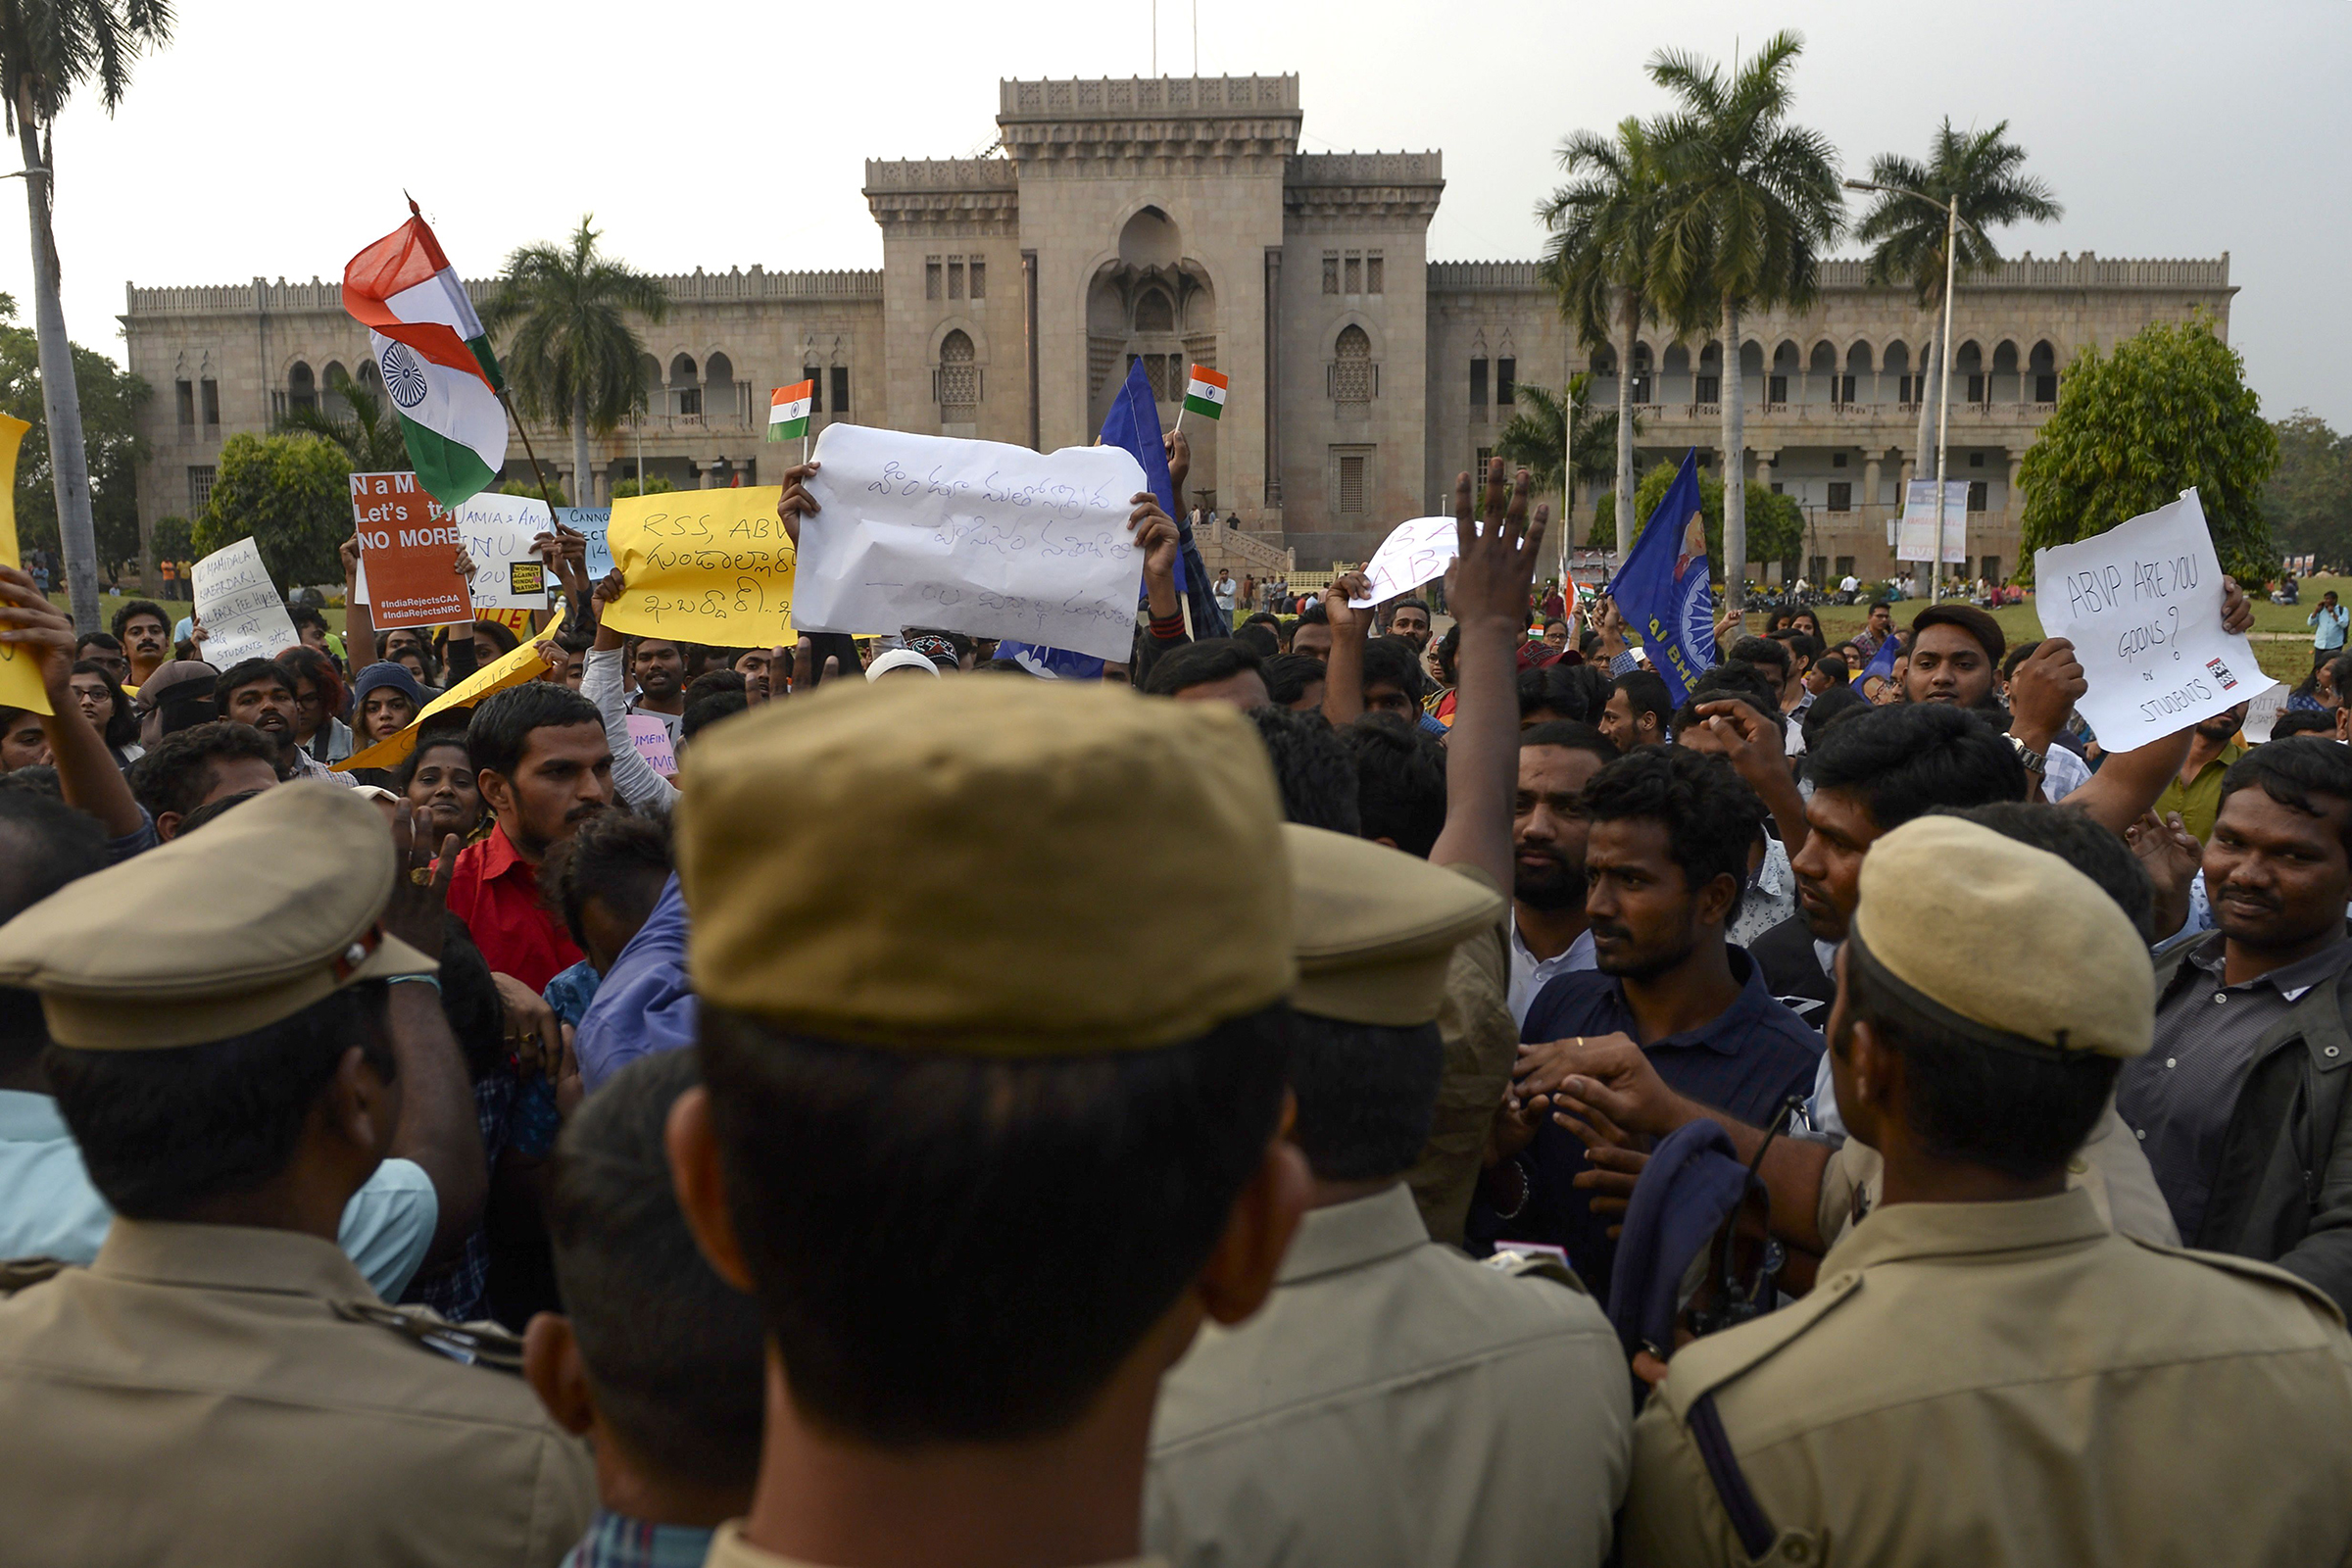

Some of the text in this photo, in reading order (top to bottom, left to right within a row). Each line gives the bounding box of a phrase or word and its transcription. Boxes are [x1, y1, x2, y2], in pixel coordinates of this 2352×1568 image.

[354, 502, 408, 523] Let's
[456, 502, 503, 524] JAMIA
[570, 510, 612, 522] CANNO
[359, 526, 460, 550] NO MORE
[2067, 554, 2198, 618] ABVP ARE YOU
[235, 597, 253, 612] FEE
[381, 594, 460, 609] #IndiaRejectsCAA
[383, 605, 462, 619] #IndiaRejectsNRC
[1649, 613, 1668, 642] AI
[217, 641, 263, 662] STUDENTS
[2140, 678, 2212, 722] STUDENTS
